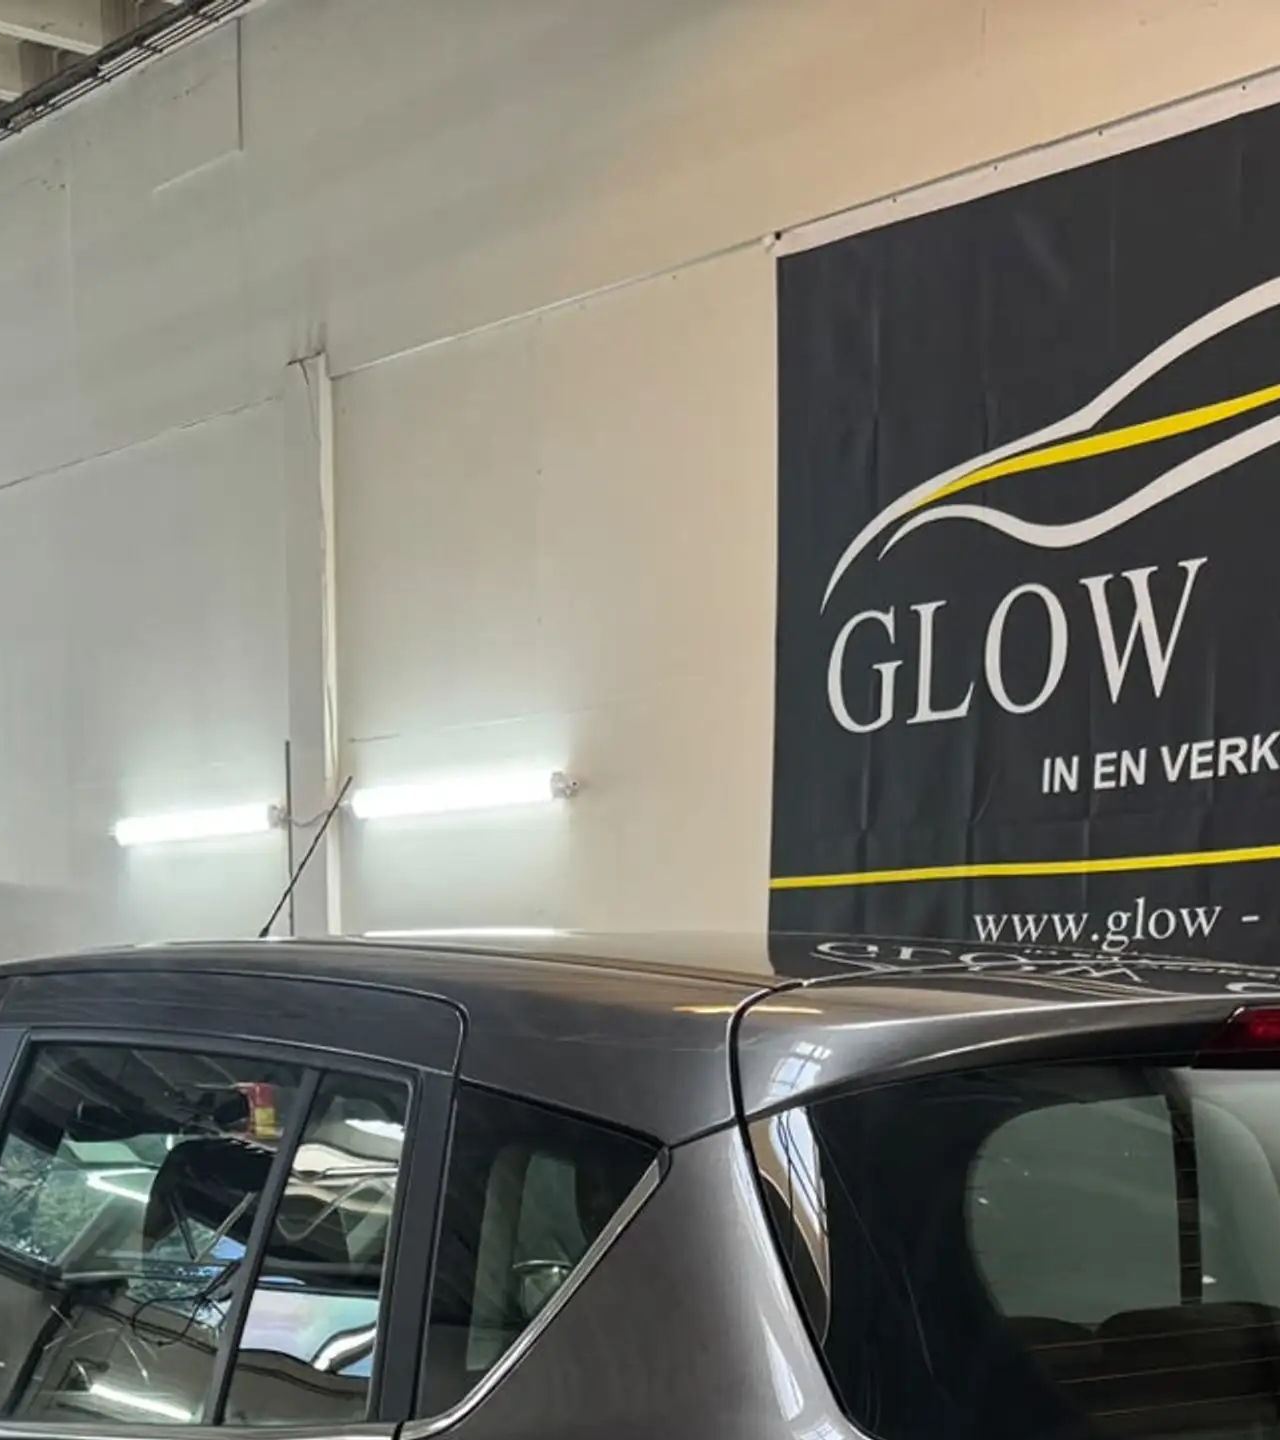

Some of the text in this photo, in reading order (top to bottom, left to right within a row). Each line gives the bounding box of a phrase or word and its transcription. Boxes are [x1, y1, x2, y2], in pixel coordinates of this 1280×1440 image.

[826, 557, 1208, 734] GLOW
[1041, 755, 1080, 794] IN
[1093, 748, 1147, 790] EN
[972, 896, 1223, 952] www.glow
